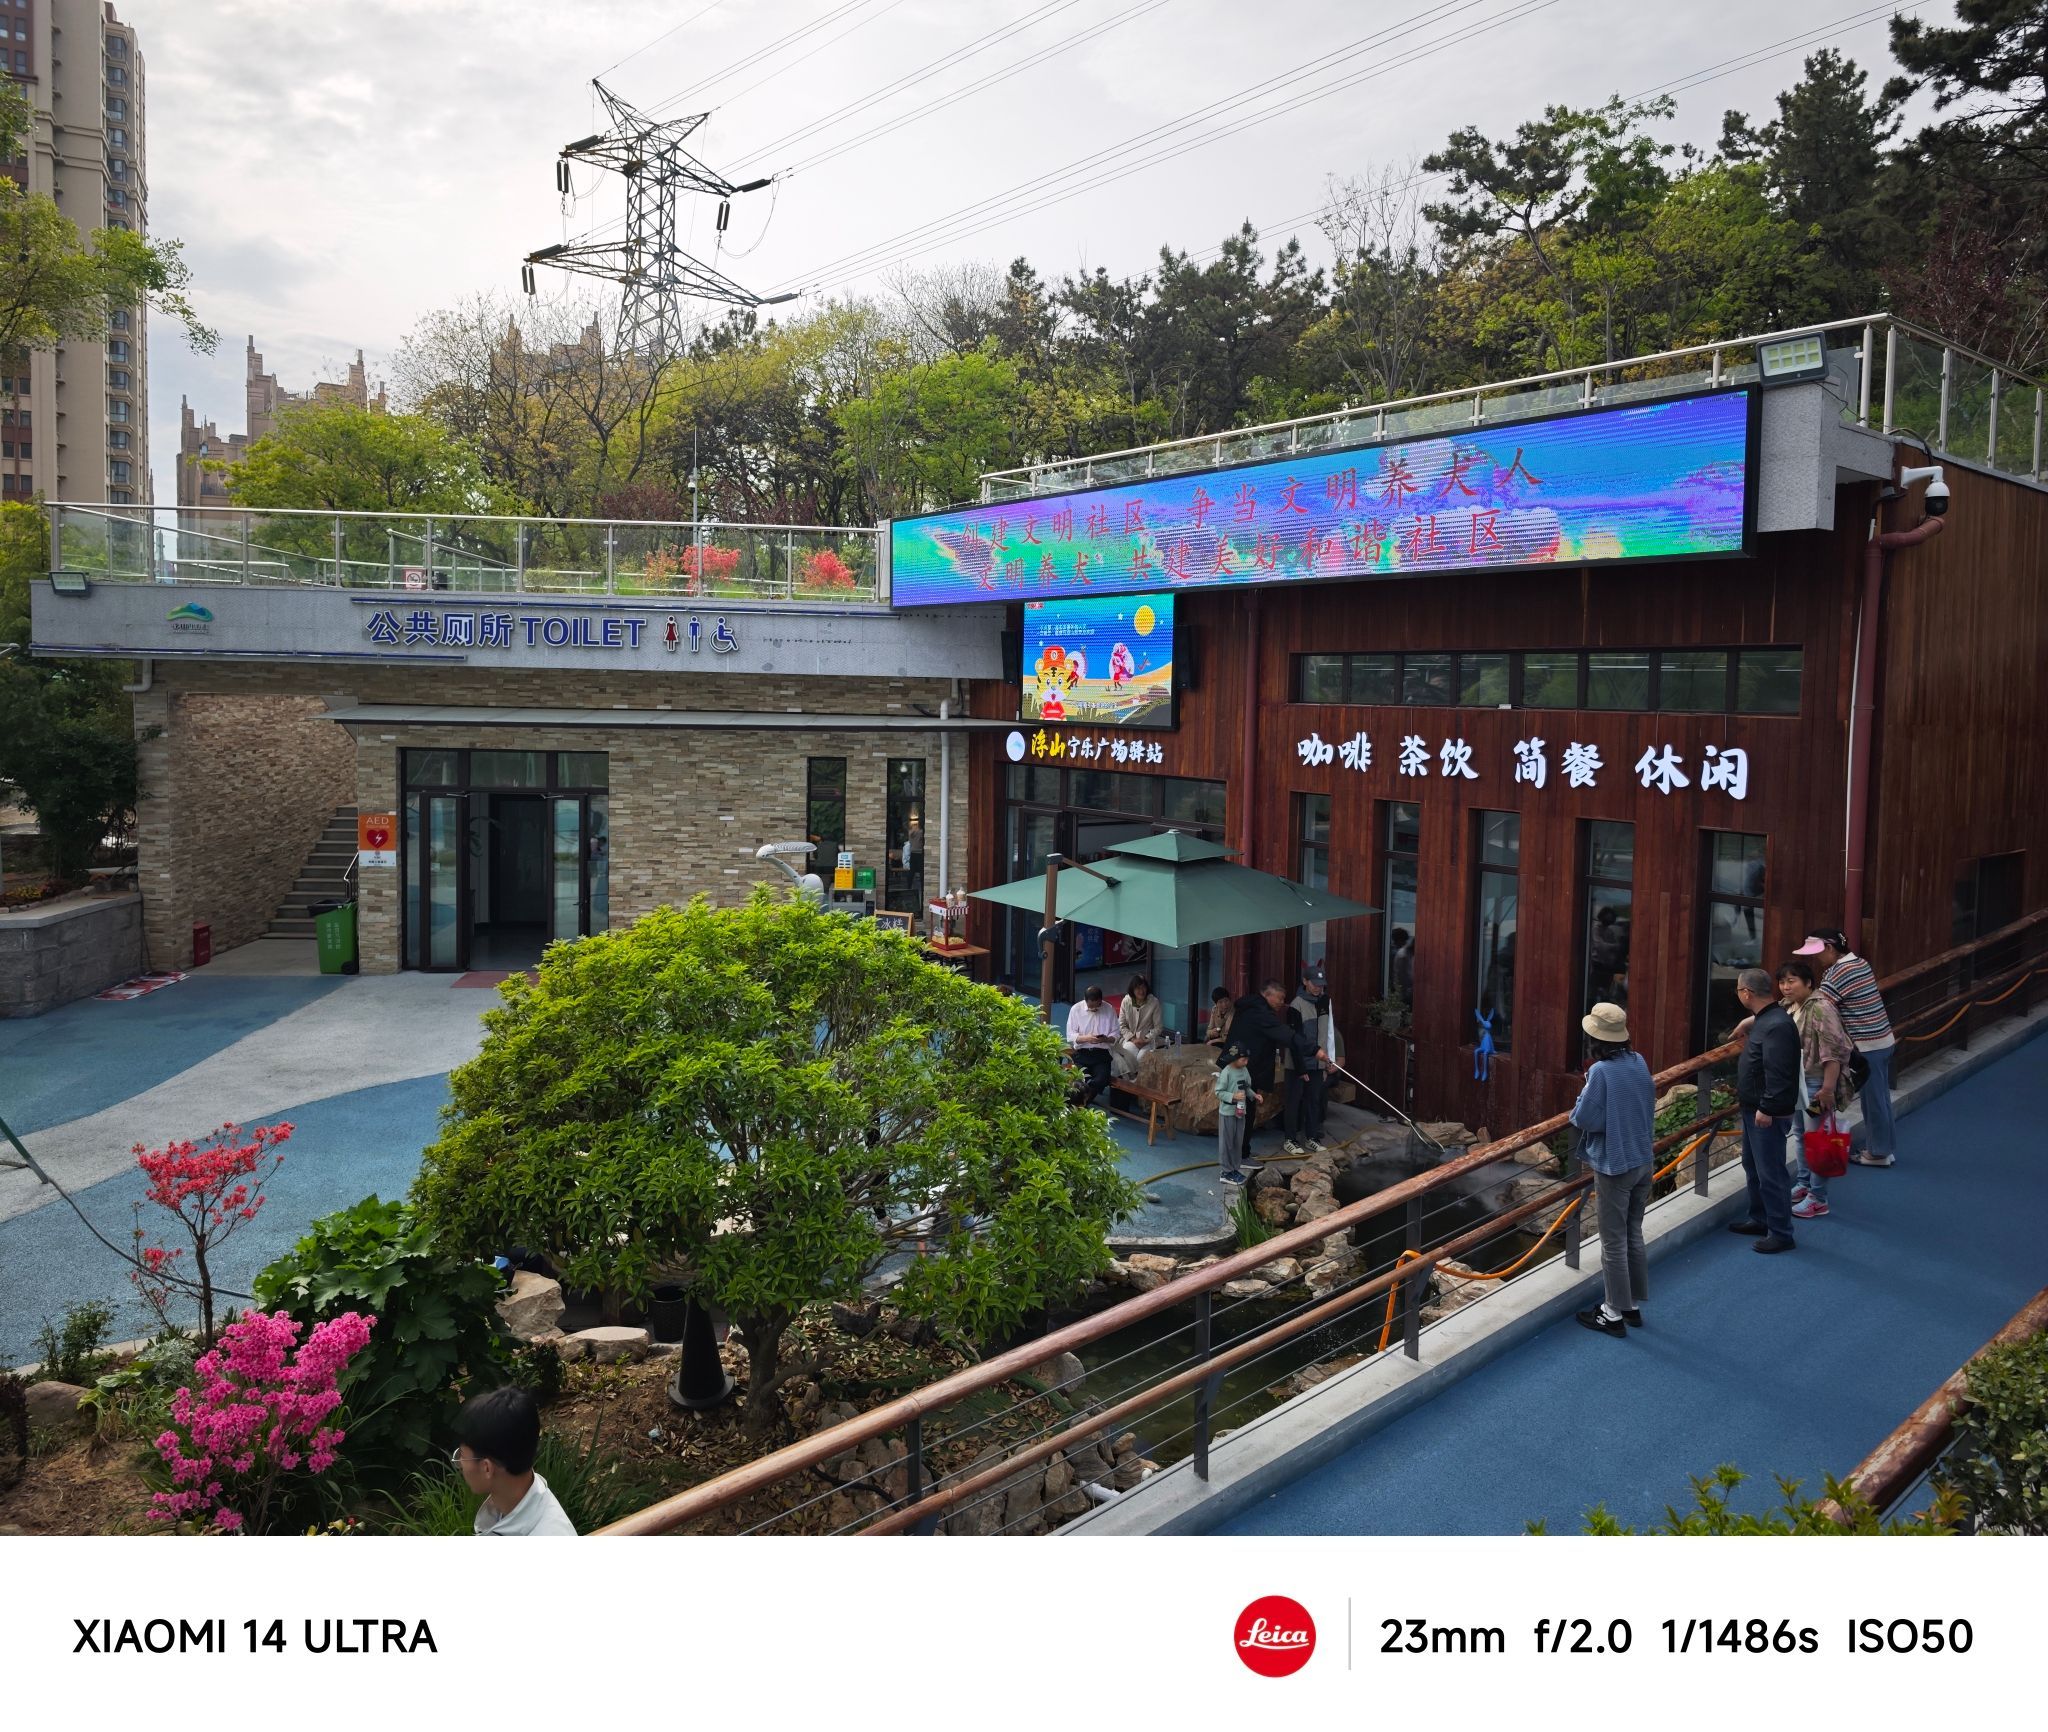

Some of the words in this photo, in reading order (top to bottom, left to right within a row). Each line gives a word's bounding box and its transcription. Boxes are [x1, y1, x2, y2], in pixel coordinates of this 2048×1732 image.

[962, 499, 1146, 553] 创建文明社区
[1186, 448, 1544, 530] 争当文明养犬人
[977, 551, 1093, 592] 文明养犬
[1127, 509, 1505, 581] 共建美好和谐社区
[366, 610, 515, 648] 公共厕所
[518, 615, 647, 649] TOILET
[1031, 728, 1164, 764] 浮山宁乐广场驿站
[1297, 731, 1373, 773] 咖啡
[1398, 734, 1480, 780] 茶饮
[1513, 736, 1606, 789] 简餐
[1634, 744, 1750, 800] 休闲
[366, 816, 389, 825] AED
